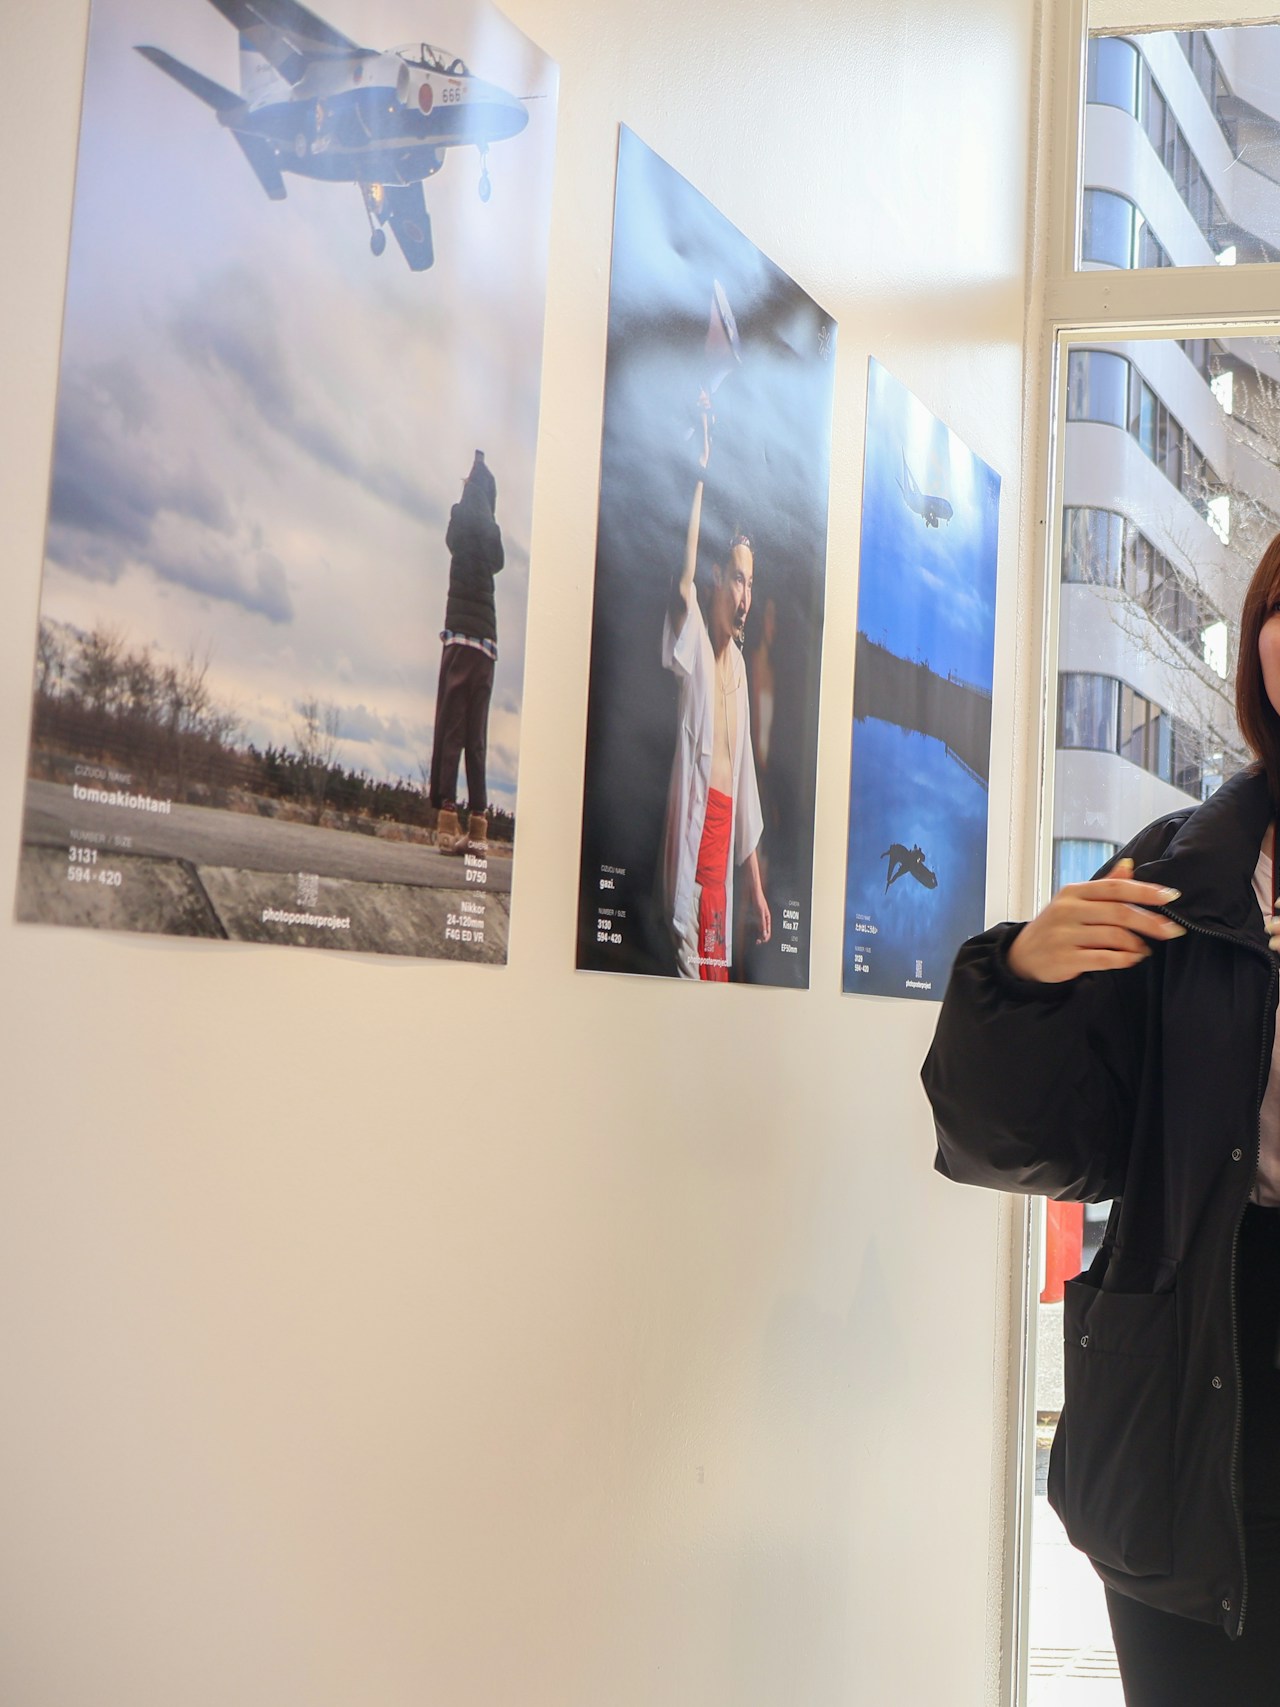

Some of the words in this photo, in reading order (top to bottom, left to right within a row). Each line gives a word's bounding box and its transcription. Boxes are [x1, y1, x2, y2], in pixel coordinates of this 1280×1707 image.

[72, 782, 172, 814] tomoakiohtani
[68, 845, 98, 864] 3131
[464, 854, 488, 869] Nikon
[465, 869, 487, 884] D750
[461, 901, 485, 914] Nikkor
[782, 909, 800, 921] CANON
[262, 907, 350, 930] photoposterproject
[446, 913, 485, 929] 24-120mm
[597, 918, 612, 930] 3130
[792, 921, 799, 931] X7
[461, 930, 472, 942] ED
[473, 931, 485, 943] VR
